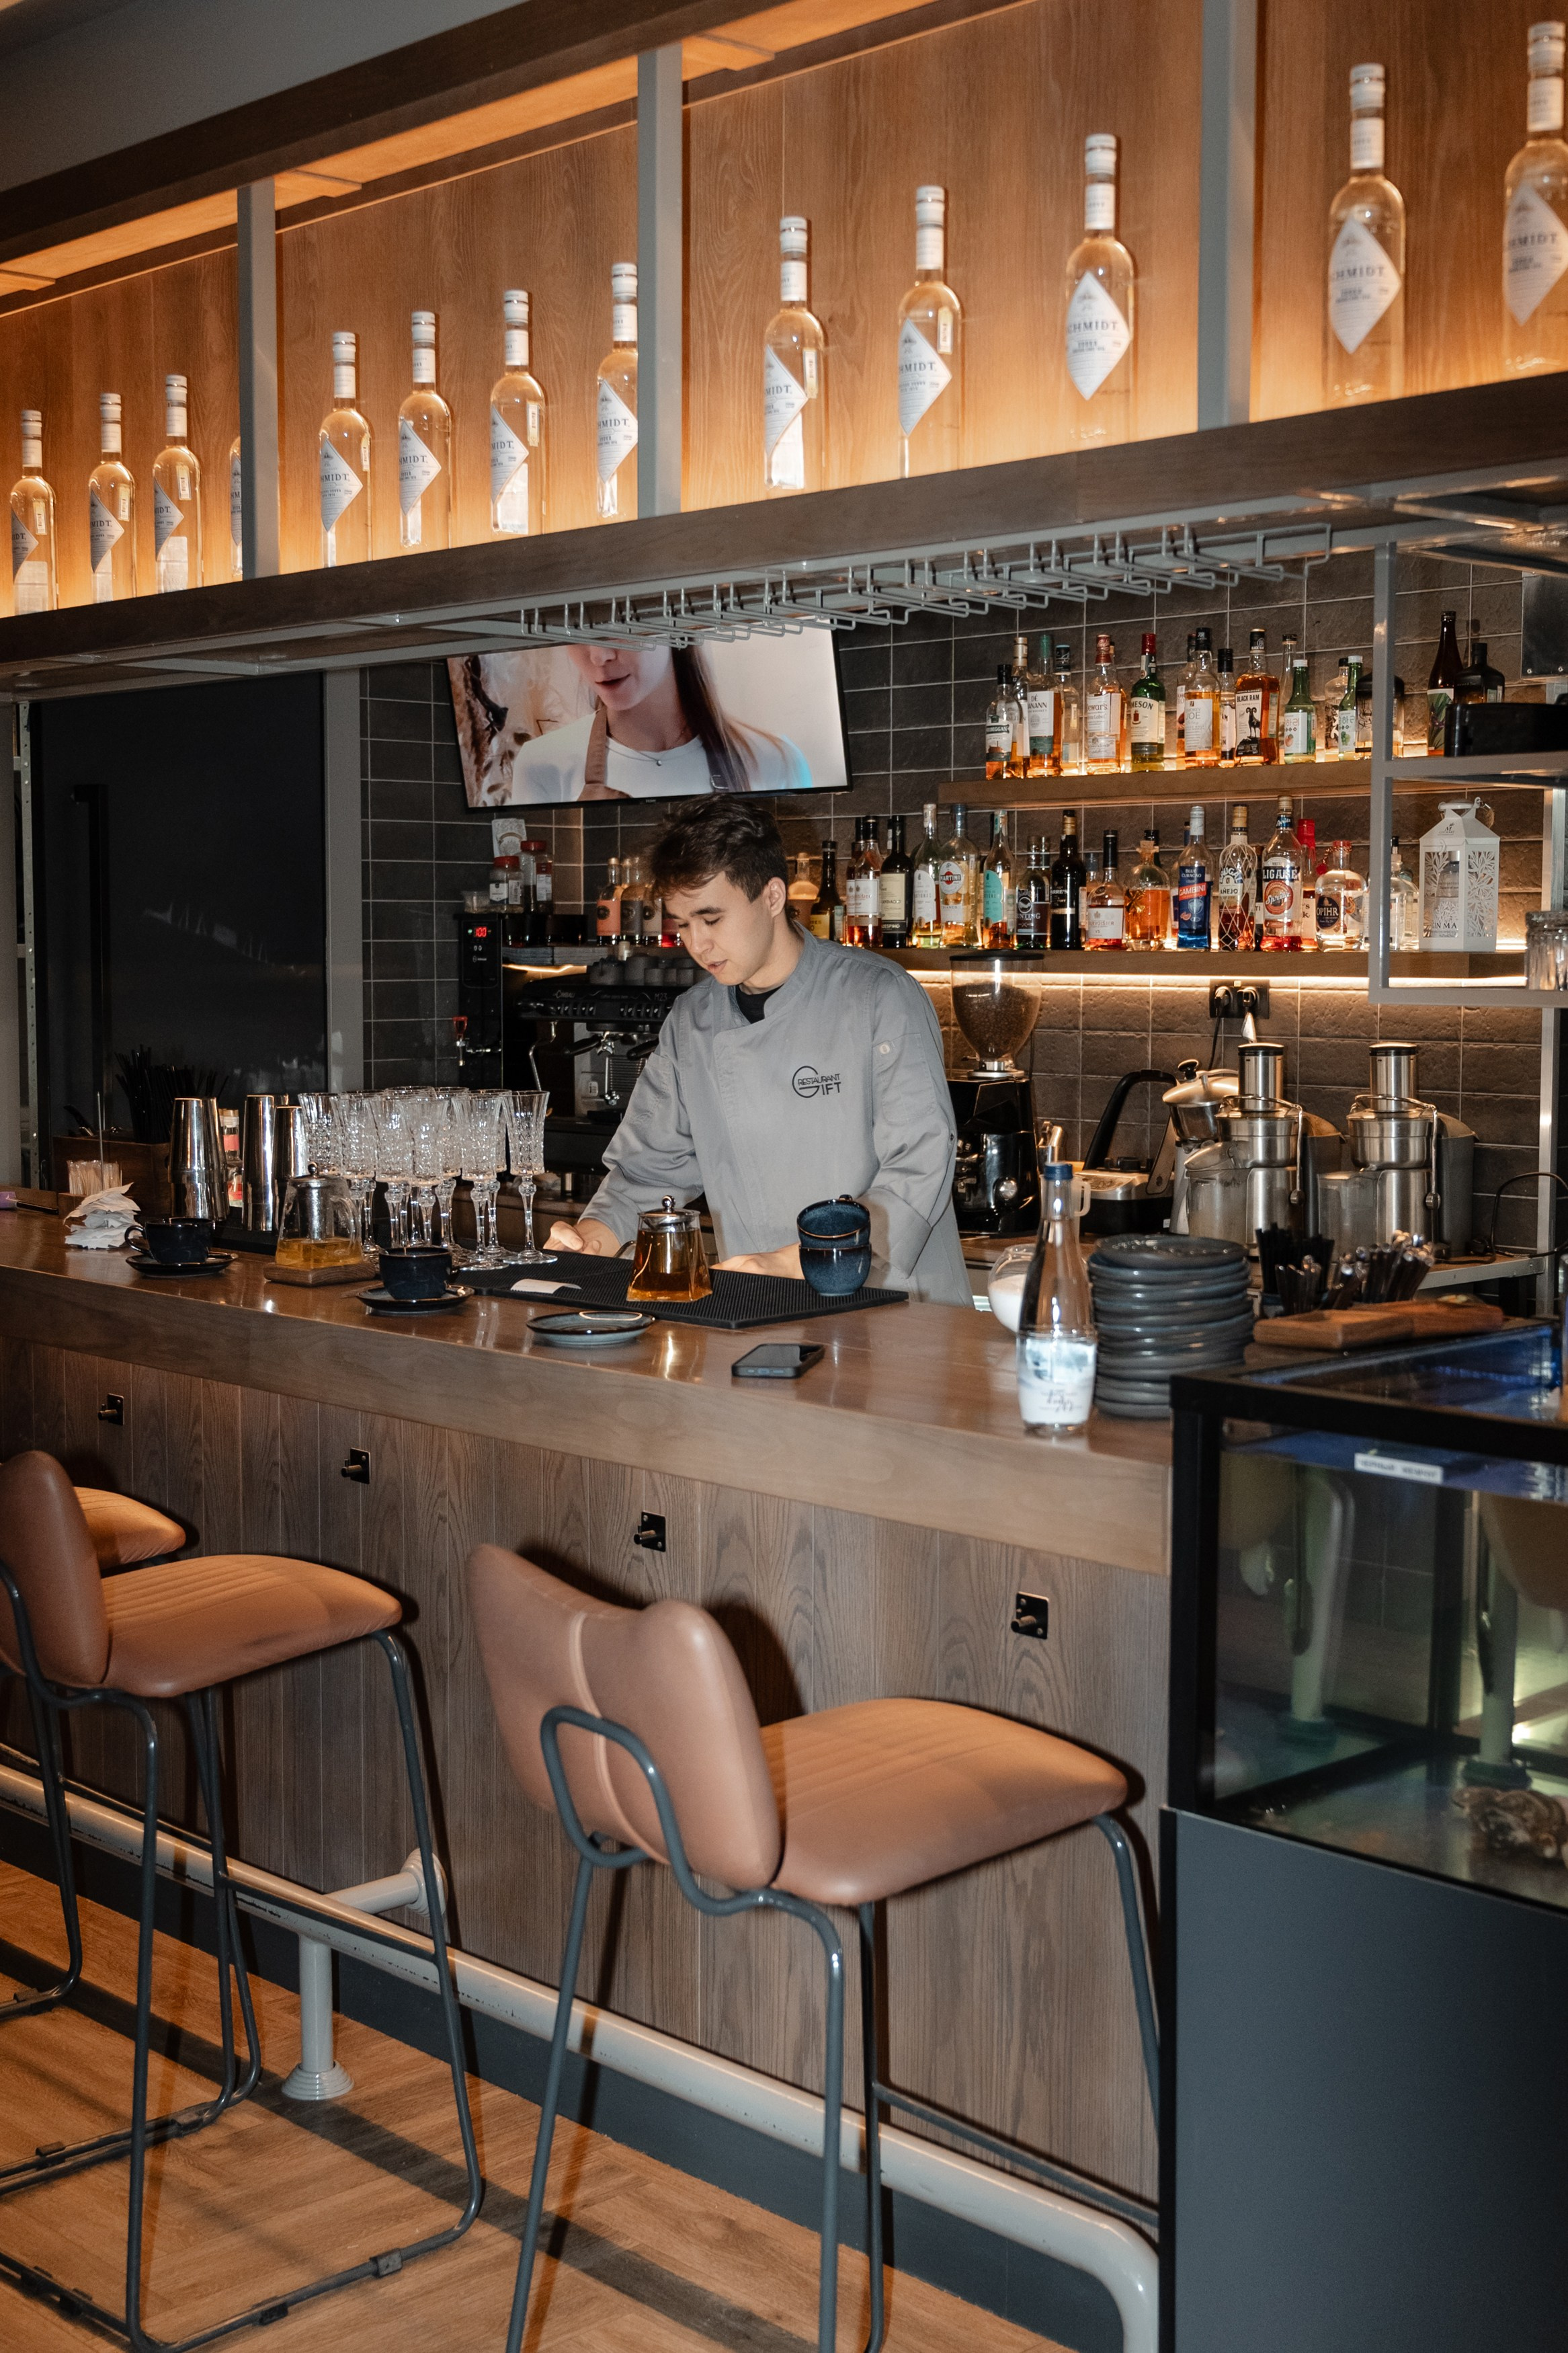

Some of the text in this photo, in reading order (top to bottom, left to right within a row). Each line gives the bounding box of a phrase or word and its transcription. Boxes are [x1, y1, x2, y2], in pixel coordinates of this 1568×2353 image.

[1186, 712, 1200, 720] JOE
[1316, 907, 1339, 916] OPIHR
[798, 1073, 841, 1086] RESTAURANT
